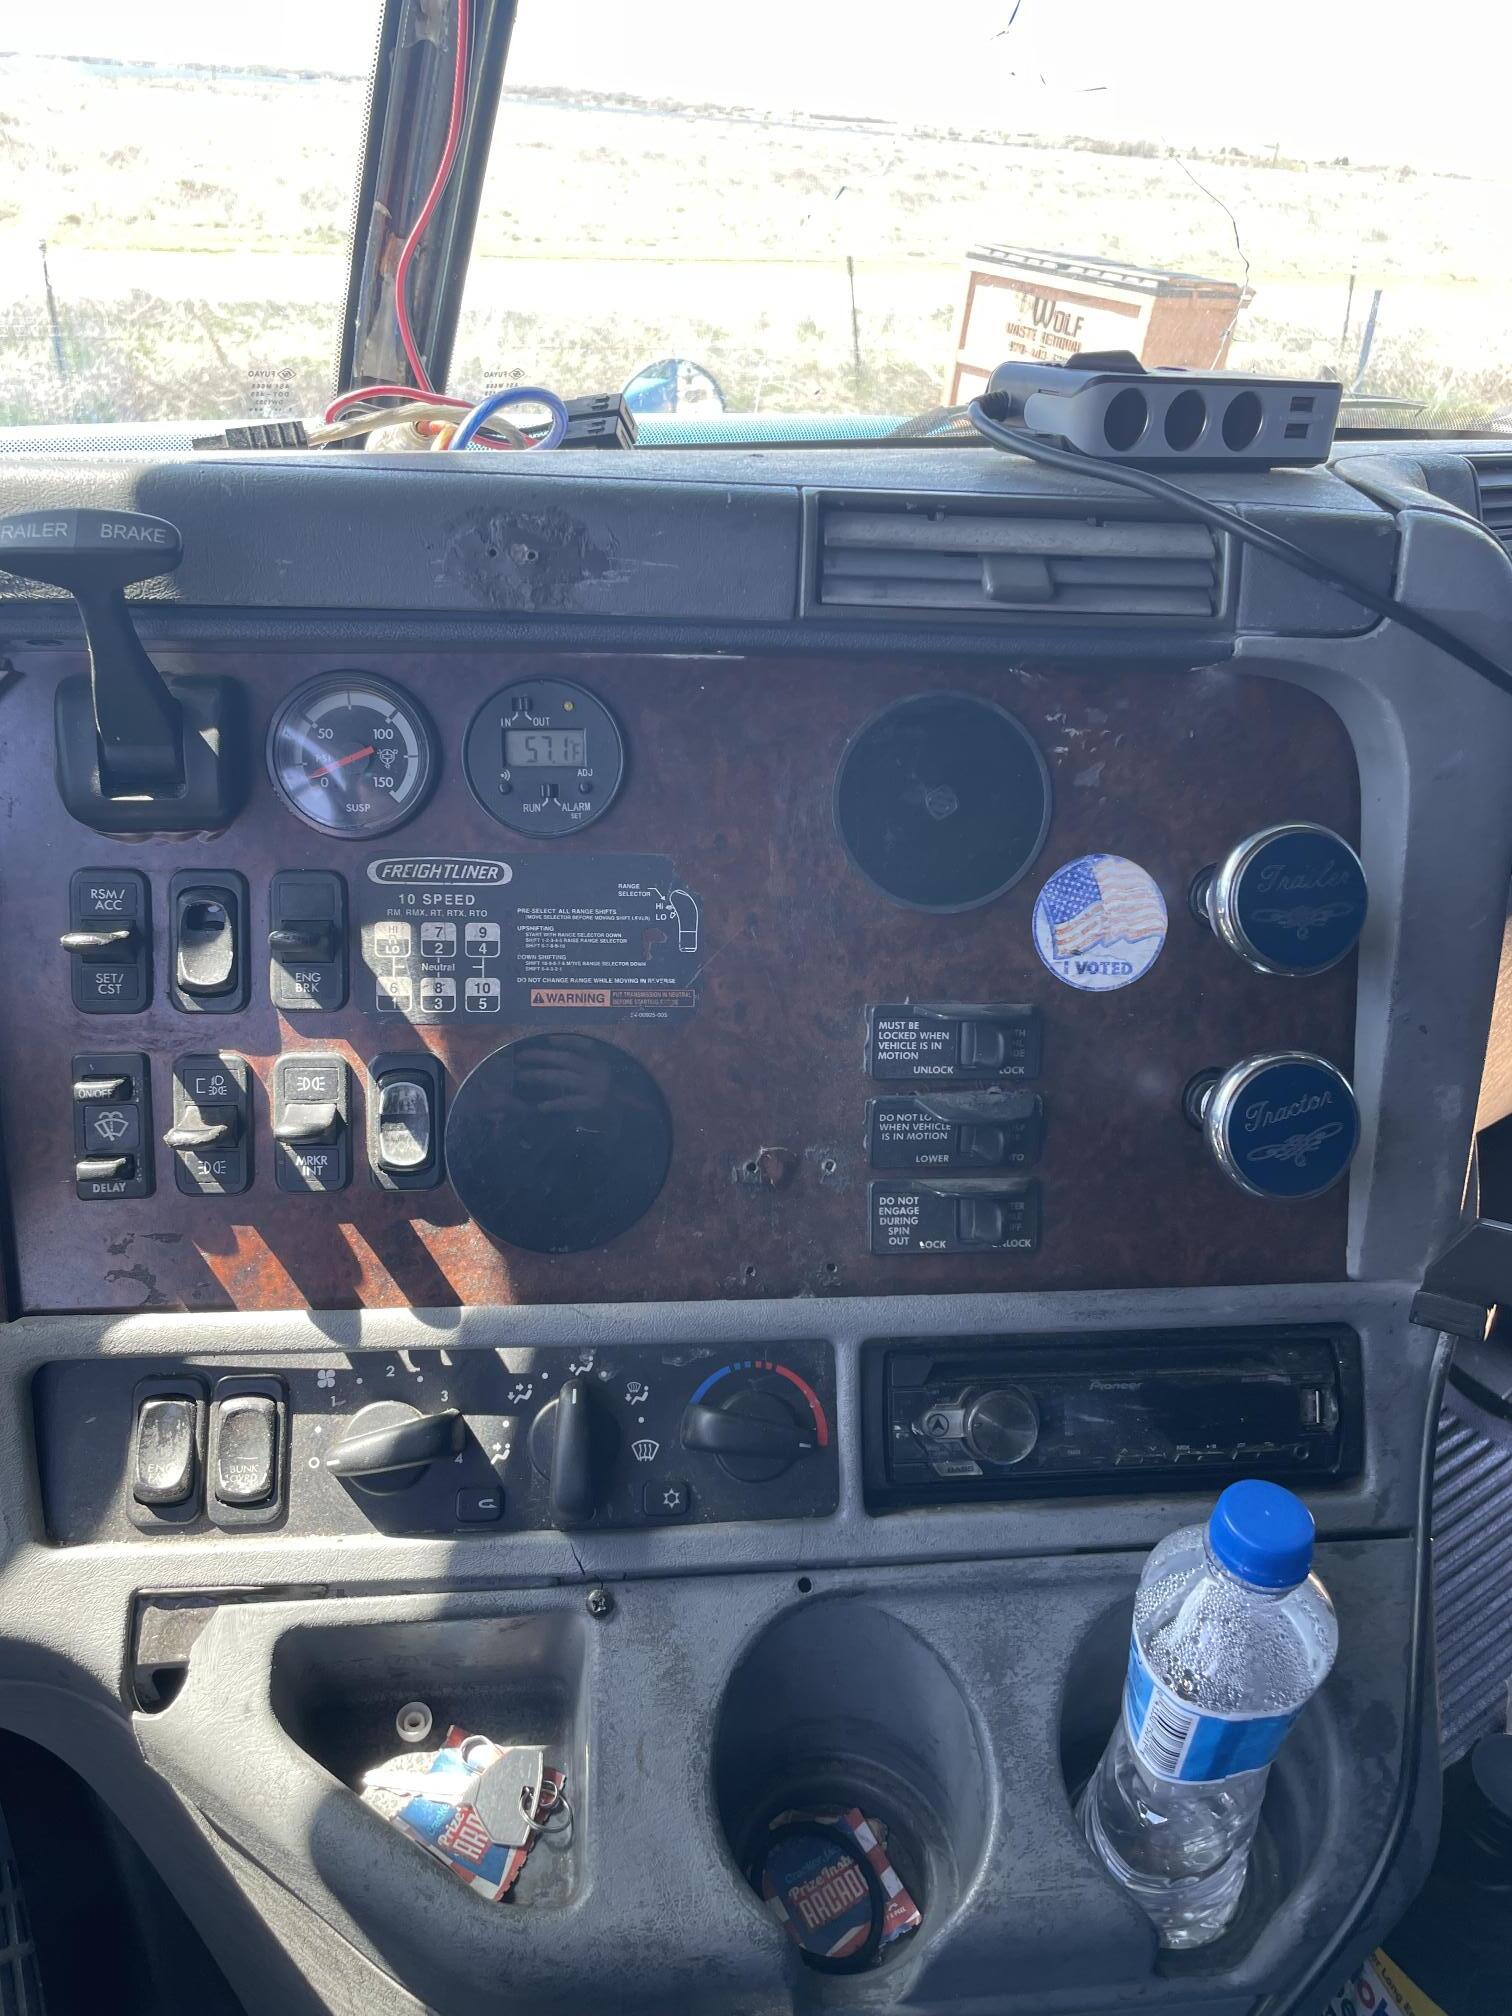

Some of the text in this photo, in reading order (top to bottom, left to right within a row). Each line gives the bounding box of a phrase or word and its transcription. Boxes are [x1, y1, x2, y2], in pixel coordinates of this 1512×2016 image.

[1032, 297, 1084, 337] WOLF
[0, 522, 166, 543] RAILER BRAKE
[501, 718, 511, 726] IN
[533, 717, 550, 726] OUT
[318, 729, 333, 739] 50
[373, 729, 393, 739] 100
[577, 769, 593, 777] ADJ
[320, 778, 328, 787] 0
[373, 777, 393, 787] 150
[346, 804, 371, 812] SUSP
[523, 804, 541, 812] RUN
[562, 803, 591, 811] ALARM
[382, 864, 499, 879] FREIGHTLINER
[1257, 859, 1350, 892] Trailer
[90, 889, 125, 900] RSM/
[399, 894, 475, 905] 10 SPEED
[95, 900, 123, 911] ACC
[435, 927, 443, 937] 7
[479, 927, 487, 937] 9
[386, 945, 400, 954] LO
[435, 943, 443, 954] 2
[479, 943, 487, 954] 4
[421, 963, 455, 972] Neutral
[1064, 961, 1133, 975] I VOTED
[95, 973, 124, 984] SET/
[295, 972, 321, 983] ENG
[97, 984, 122, 995] CST
[295, 983, 319, 993] BRK
[390, 983, 397, 993] 6
[435, 983, 443, 993] 8
[475, 983, 490, 993] 10
[546, 993, 605, 1003] WARNING
[434, 998, 442, 1009] 3
[479, 998, 487, 1009] 5
[878, 1022, 920, 1030] MUST BE
[878, 1032, 950, 1040] LOCKED WHEN
[878, 1042, 942, 1050] VEHICLE IS IN
[878, 1052, 919, 1060] MOTION
[913, 1066, 954, 1074] UNLOCK
[79, 1089, 113, 1099] ON/OFF
[1245, 1091, 1334, 1132] Tractor
[879, 1114, 894, 1122] DO
[897, 1114, 917, 1122] NOT
[879, 1122, 951, 1131] WHEN VEHICLE
[906, 1132, 948, 1140] MOTION
[296, 1155, 328, 1166] MRKR
[915, 1155, 949, 1163] LOWER
[303, 1166, 323, 1176] INT
[93, 1183, 126, 1193] DELAY
[879, 1197, 919, 1205] DO NOT
[879, 1207, 920, 1215] ENGAGE
[879, 1217, 918, 1225] DURING
[888, 1227, 910, 1235] SPIN
[889, 1237, 909, 1245] OUT
[386, 1366, 395, 1377] 2
[1089, 1380, 1143, 1391] Pioneer
[441, 1391, 449, 1402] 3
[454, 1454, 463, 1464] 4
[229, 1464, 259, 1473] BUNK
[788, 1876, 822, 1901] Prize
